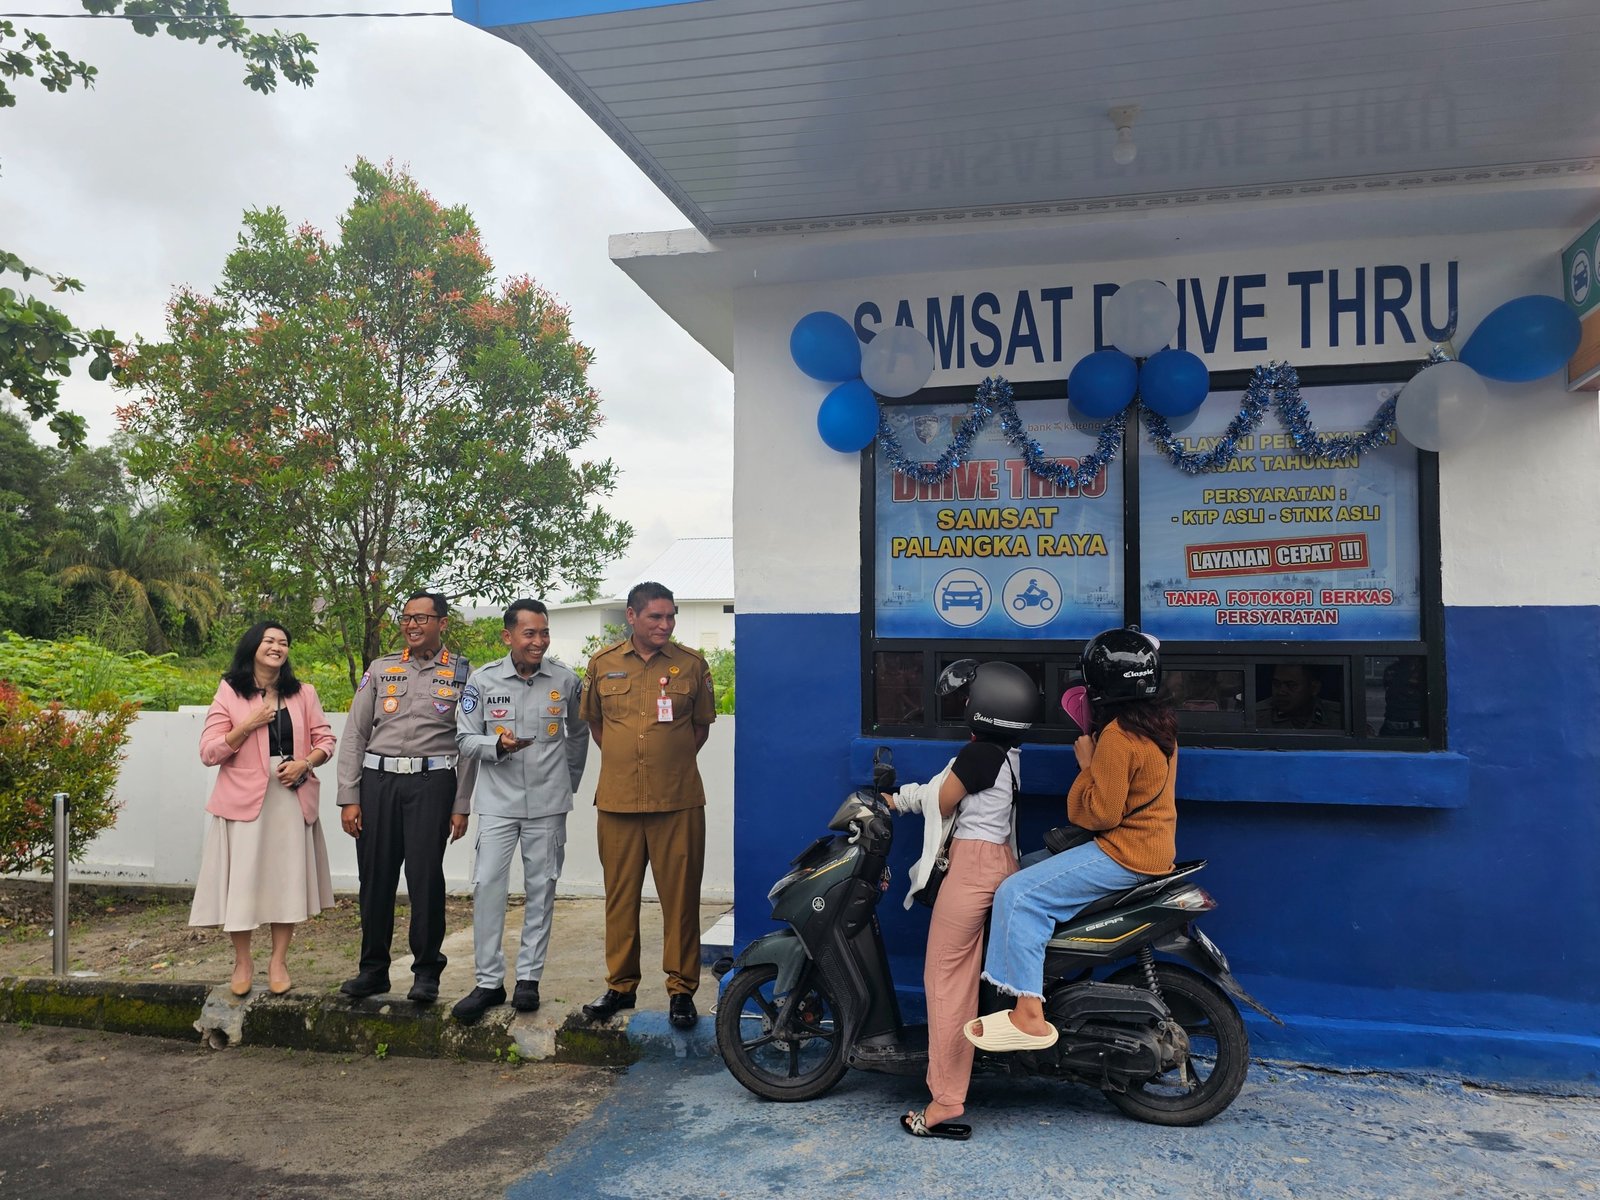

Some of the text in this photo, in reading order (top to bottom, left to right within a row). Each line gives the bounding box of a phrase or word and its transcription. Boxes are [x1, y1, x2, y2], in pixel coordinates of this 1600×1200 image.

[1093, 274, 1268, 354] DIVE
[1287, 261, 1459, 349] THRU
[1027, 422, 1051, 433] bank
[1260, 453, 1359, 471] TAHUNAN
[1203, 486, 1335, 503] PERSYARATAN
[937, 507, 1059, 530] SAMSAT
[1182, 509, 1219, 525] KTP
[1223, 508, 1264, 524] ASLI
[1279, 507, 1332, 523] STNK
[1336, 505, 1380, 521] ASLI
[892, 533, 1108, 558] PALANGKA RAYA
[1190, 548, 1270, 571] LAYANAN
[1276, 543, 1334, 566] CEPAT
[1164, 589, 1393, 606] TANPA FOTOKOPI BERKAS
[1216, 609, 1338, 625] PERSYARATAN
[380, 675, 408, 683] YUSEP
[1123, 668, 1154, 679] Classic
[487, 696, 511, 704] ALFIN
[1086, 916, 1124, 932] GEAR
